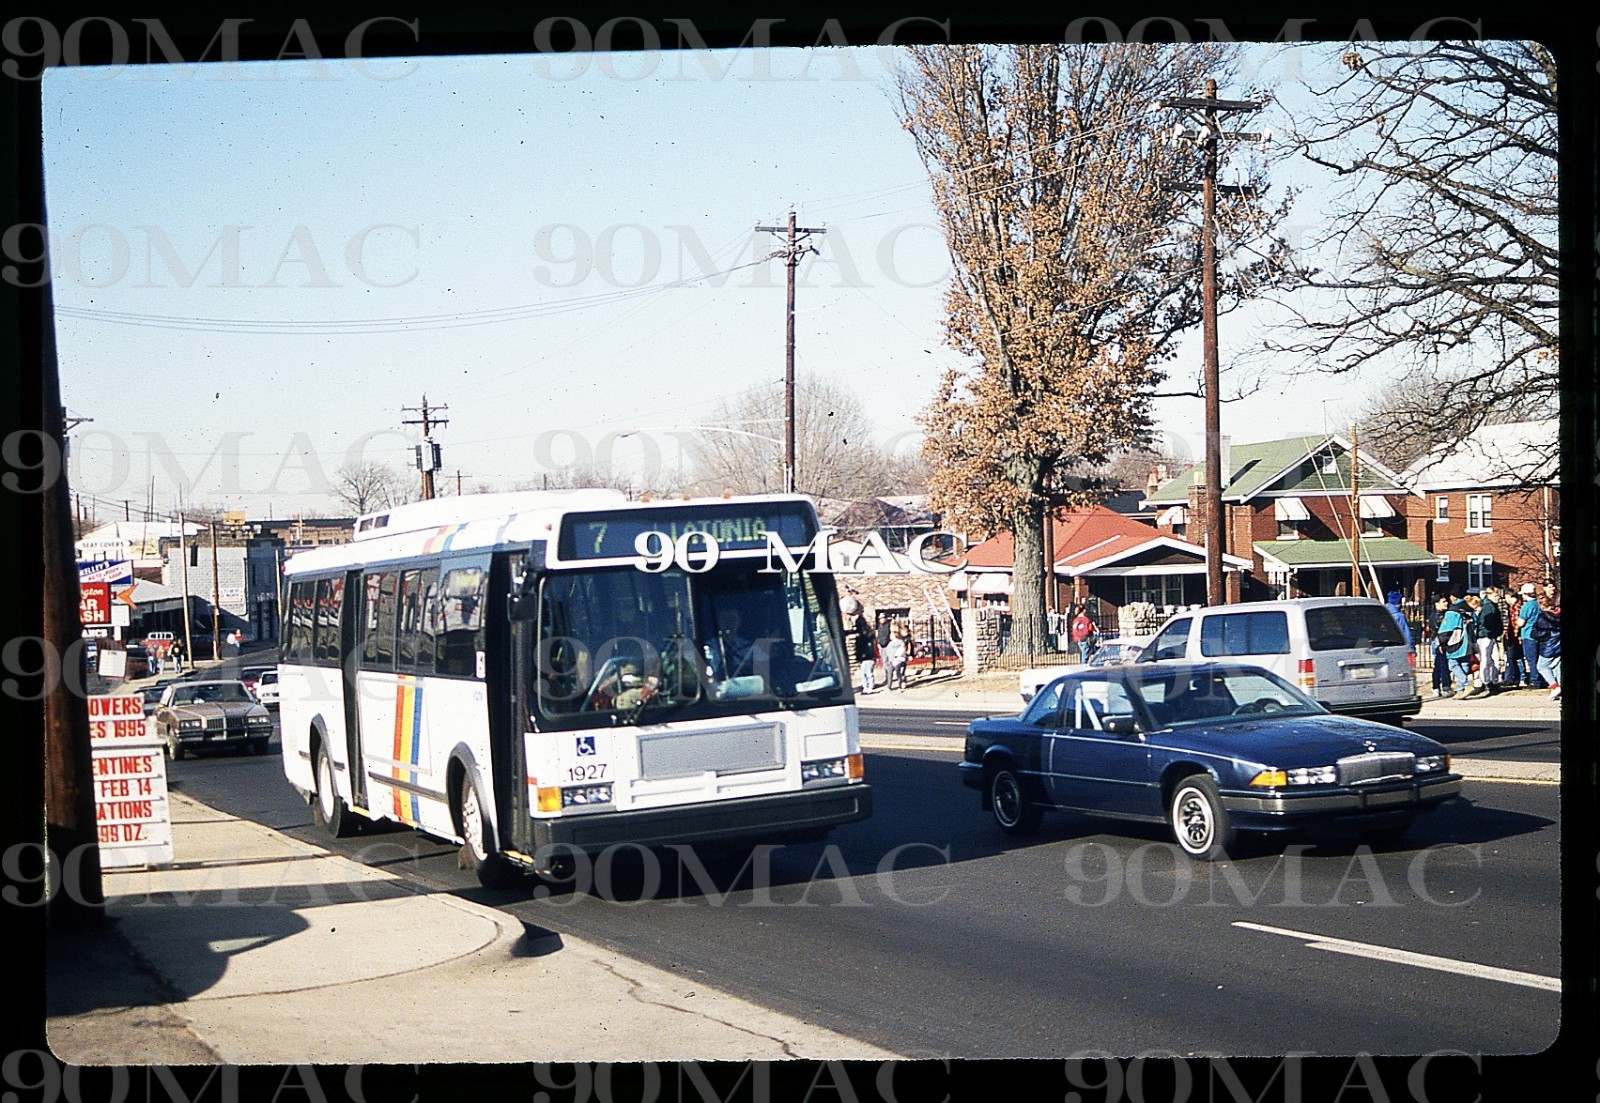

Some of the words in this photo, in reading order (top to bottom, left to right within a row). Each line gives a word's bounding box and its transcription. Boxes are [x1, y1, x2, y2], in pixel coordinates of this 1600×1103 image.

[588, 521, 608, 553] 7
[80, 588, 104, 599] gton
[112, 720, 147, 738] 1995
[568, 763, 608, 782] 1927
[101, 779, 130, 797] FEB
[137, 777, 153, 796] 14
